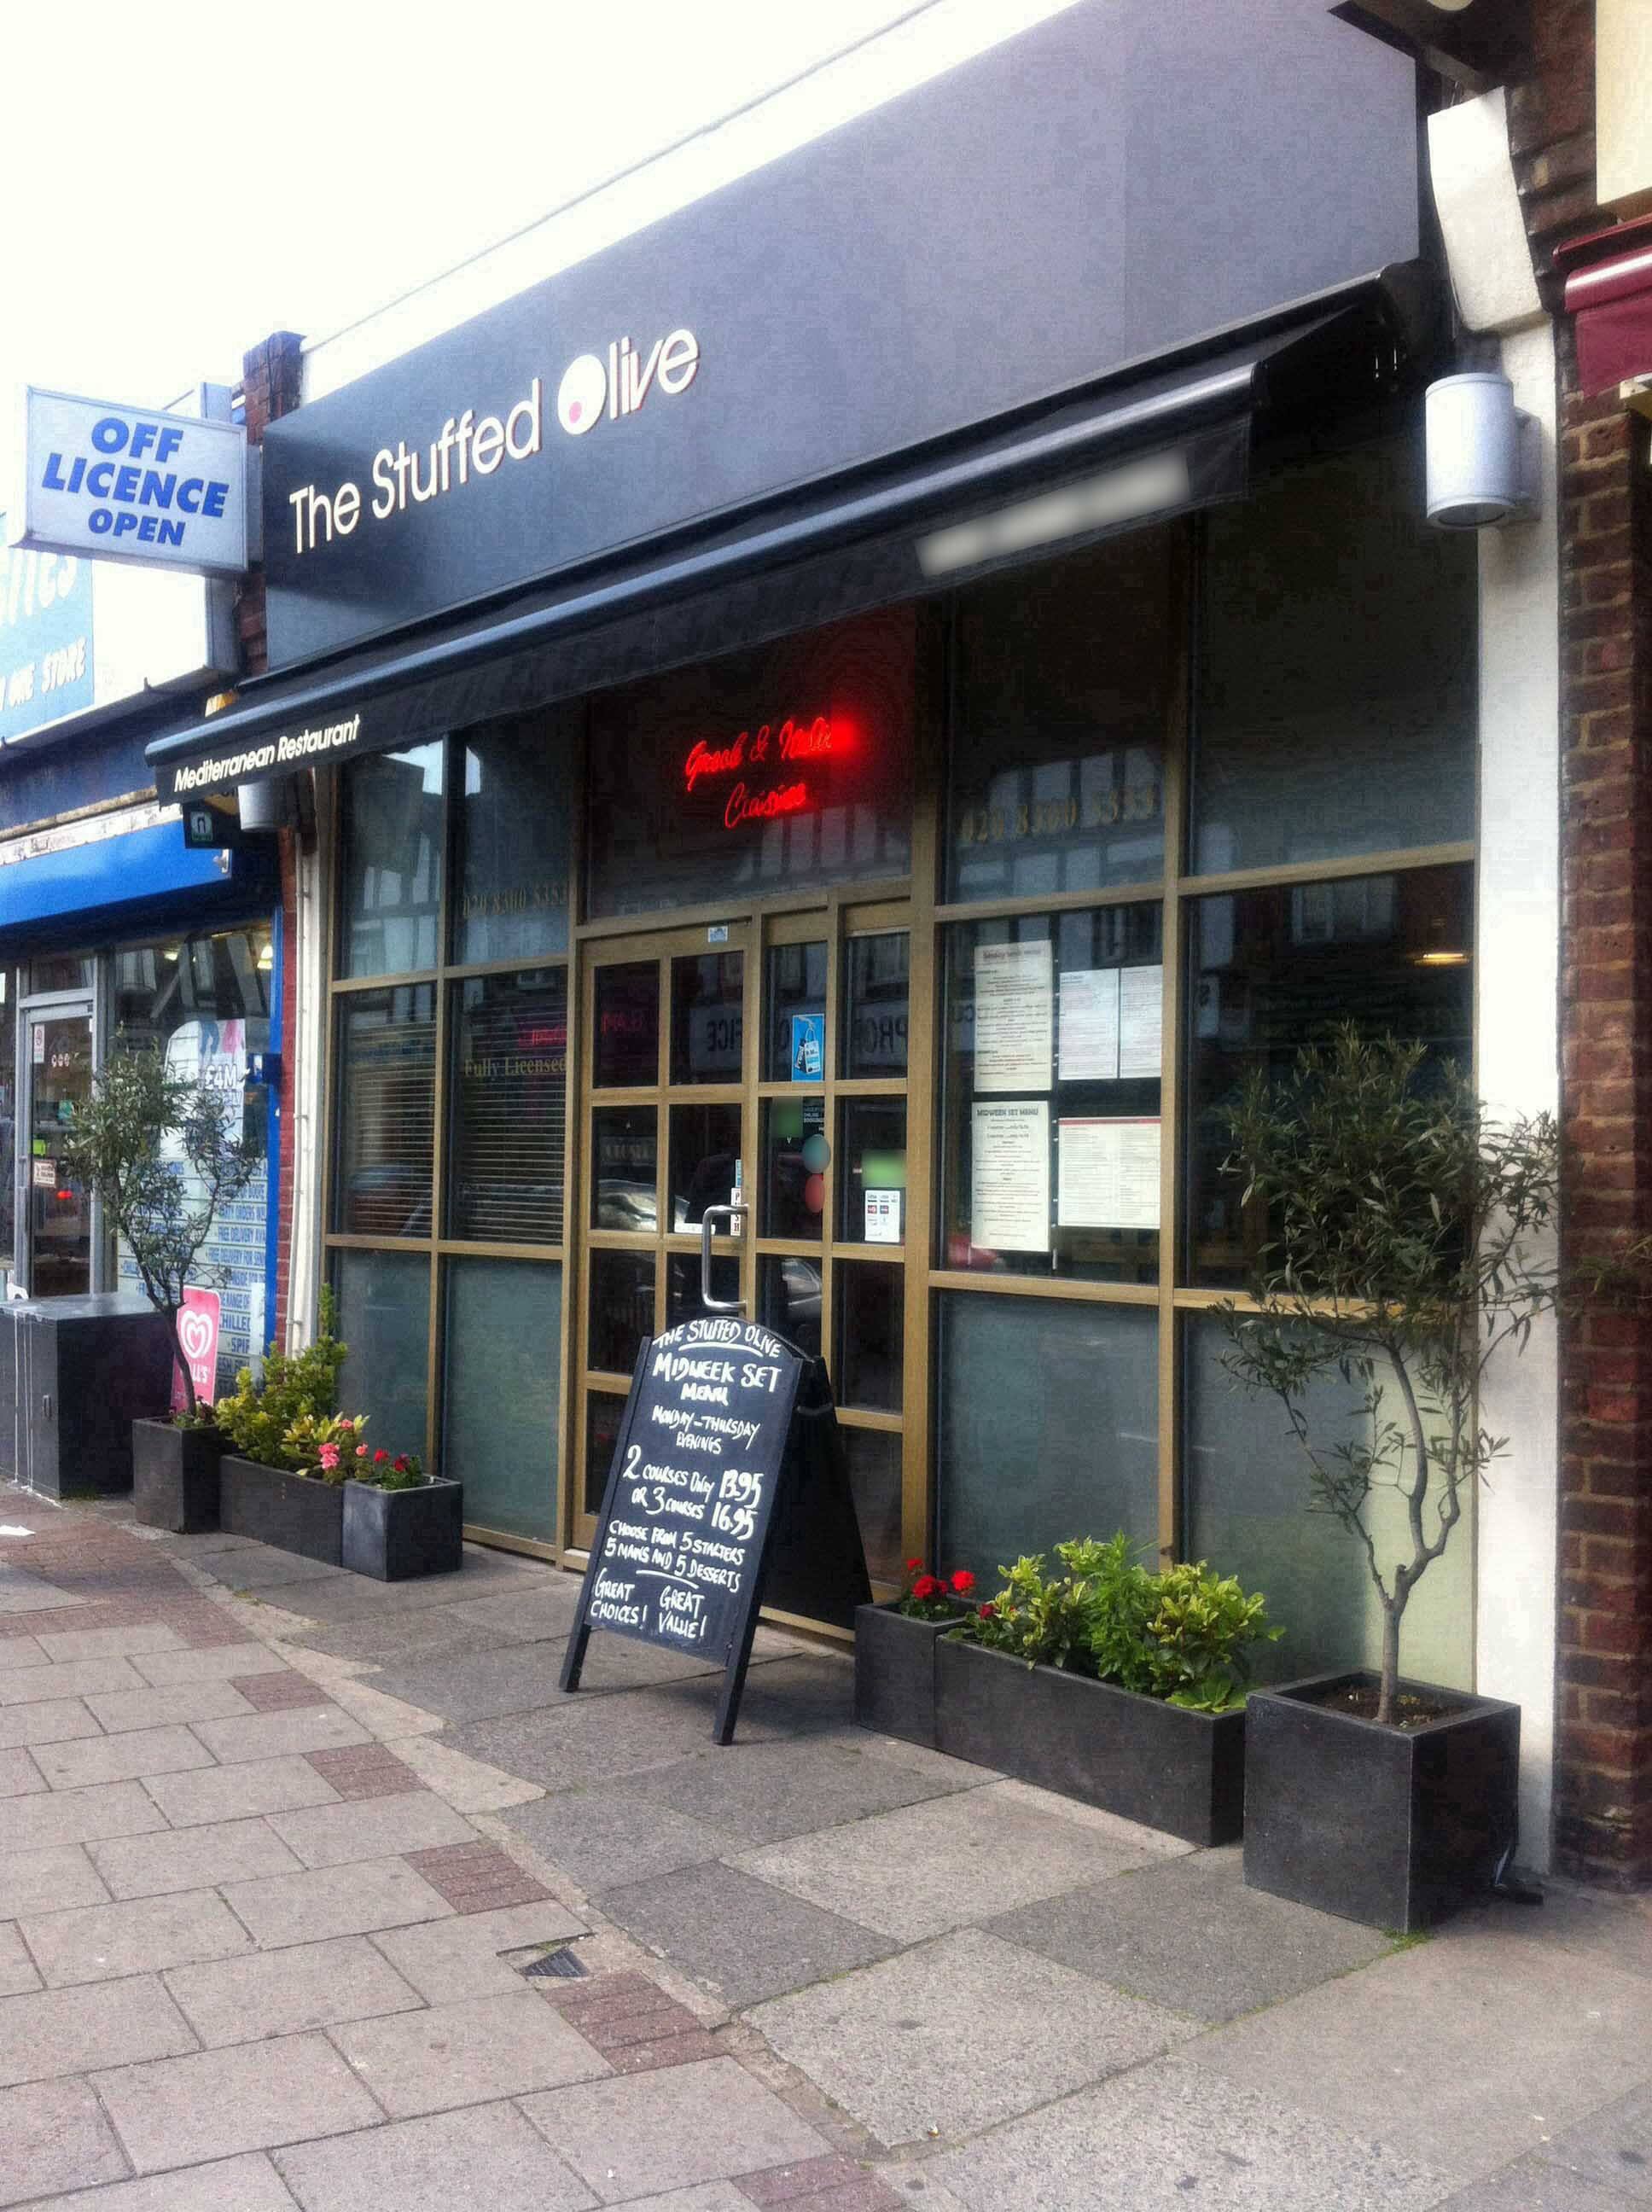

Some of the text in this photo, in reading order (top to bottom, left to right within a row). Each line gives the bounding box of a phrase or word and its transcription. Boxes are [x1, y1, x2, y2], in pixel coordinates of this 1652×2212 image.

[90, 417, 183, 463] OFF
[289, 329, 700, 554] The Stuffed Olive
[42, 452, 230, 518] LICENCE
[88, 508, 185, 546] OPEN
[174, 713, 360, 792] Mediterranean Restaurant
[464, 1058, 498, 1082] Fully
[652, 1324, 685, 1348] THE
[744, 1324, 782, 1358] OLIVE
[652, 1352, 782, 1393] MIDWEEK SET
[680, 1382, 729, 1406] MENU
[676, 1431, 722, 1454] EVENINGS
[623, 1445, 642, 1480] 2
[643, 1464, 689, 1487] COURSES
[631, 1487, 758, 1540] OR 3 COURSES 16.95
[609, 1520, 745, 1565] CHOOSE FROM 5 STARTERS
[594, 1567, 635, 1602] GREAT
[604, 1538, 741, 1592] 5 MAINS AND 5 DESSERTS
[660, 1586, 705, 1619] GREAT
[659, 1612, 707, 1644] VALUE!
